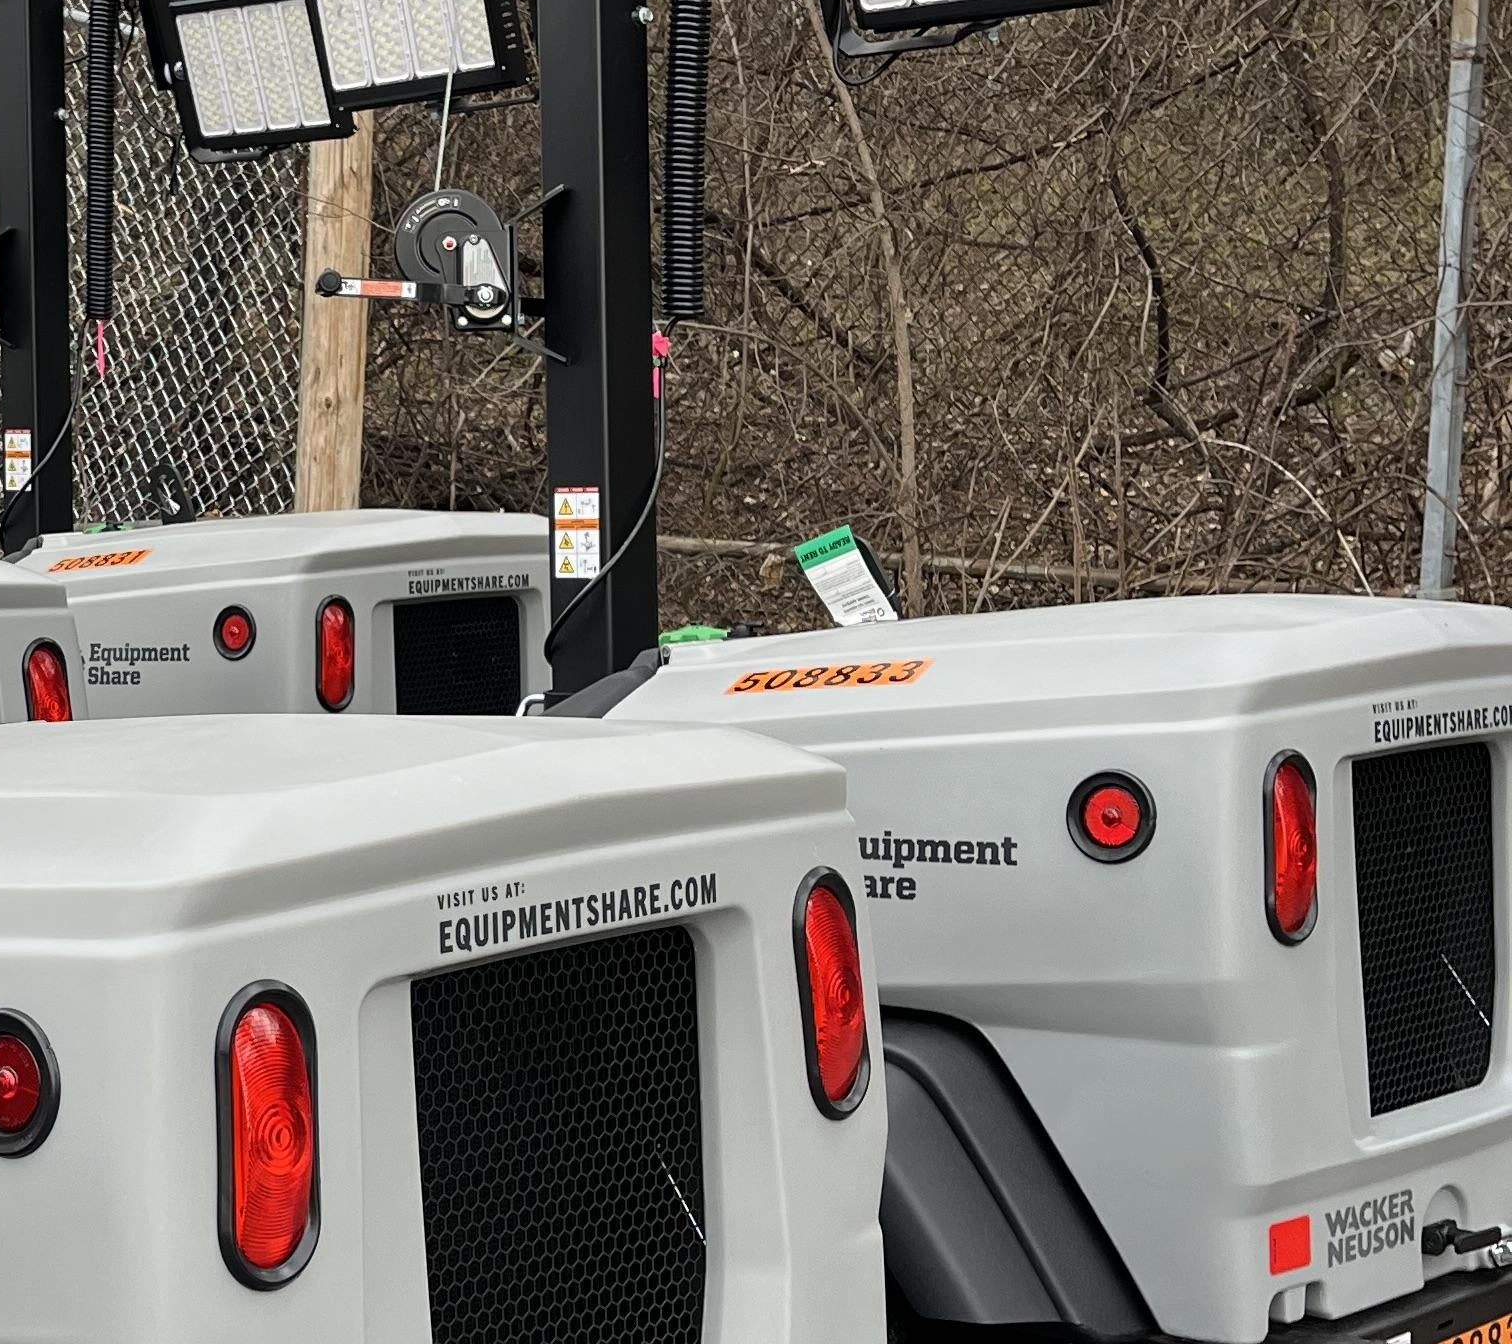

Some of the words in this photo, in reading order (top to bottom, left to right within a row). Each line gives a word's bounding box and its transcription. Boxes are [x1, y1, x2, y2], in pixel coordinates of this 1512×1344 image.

[48, 549, 147, 572] 508831
[409, 574, 529, 595] EQUIPMENTSHARE.COM
[89, 643, 190, 666] Equipment
[88, 666, 141, 685] Share
[734, 660, 924, 692] 508833
[437, 889, 474, 910] VISIT
[482, 886, 499, 902] US
[505, 881, 526, 898] AT:
[439, 873, 717, 954] EQUIPMENTSHARE.COM
[1325, 1189, 1414, 1237] WACKER
[1327, 1216, 1415, 1268] NEUSON
